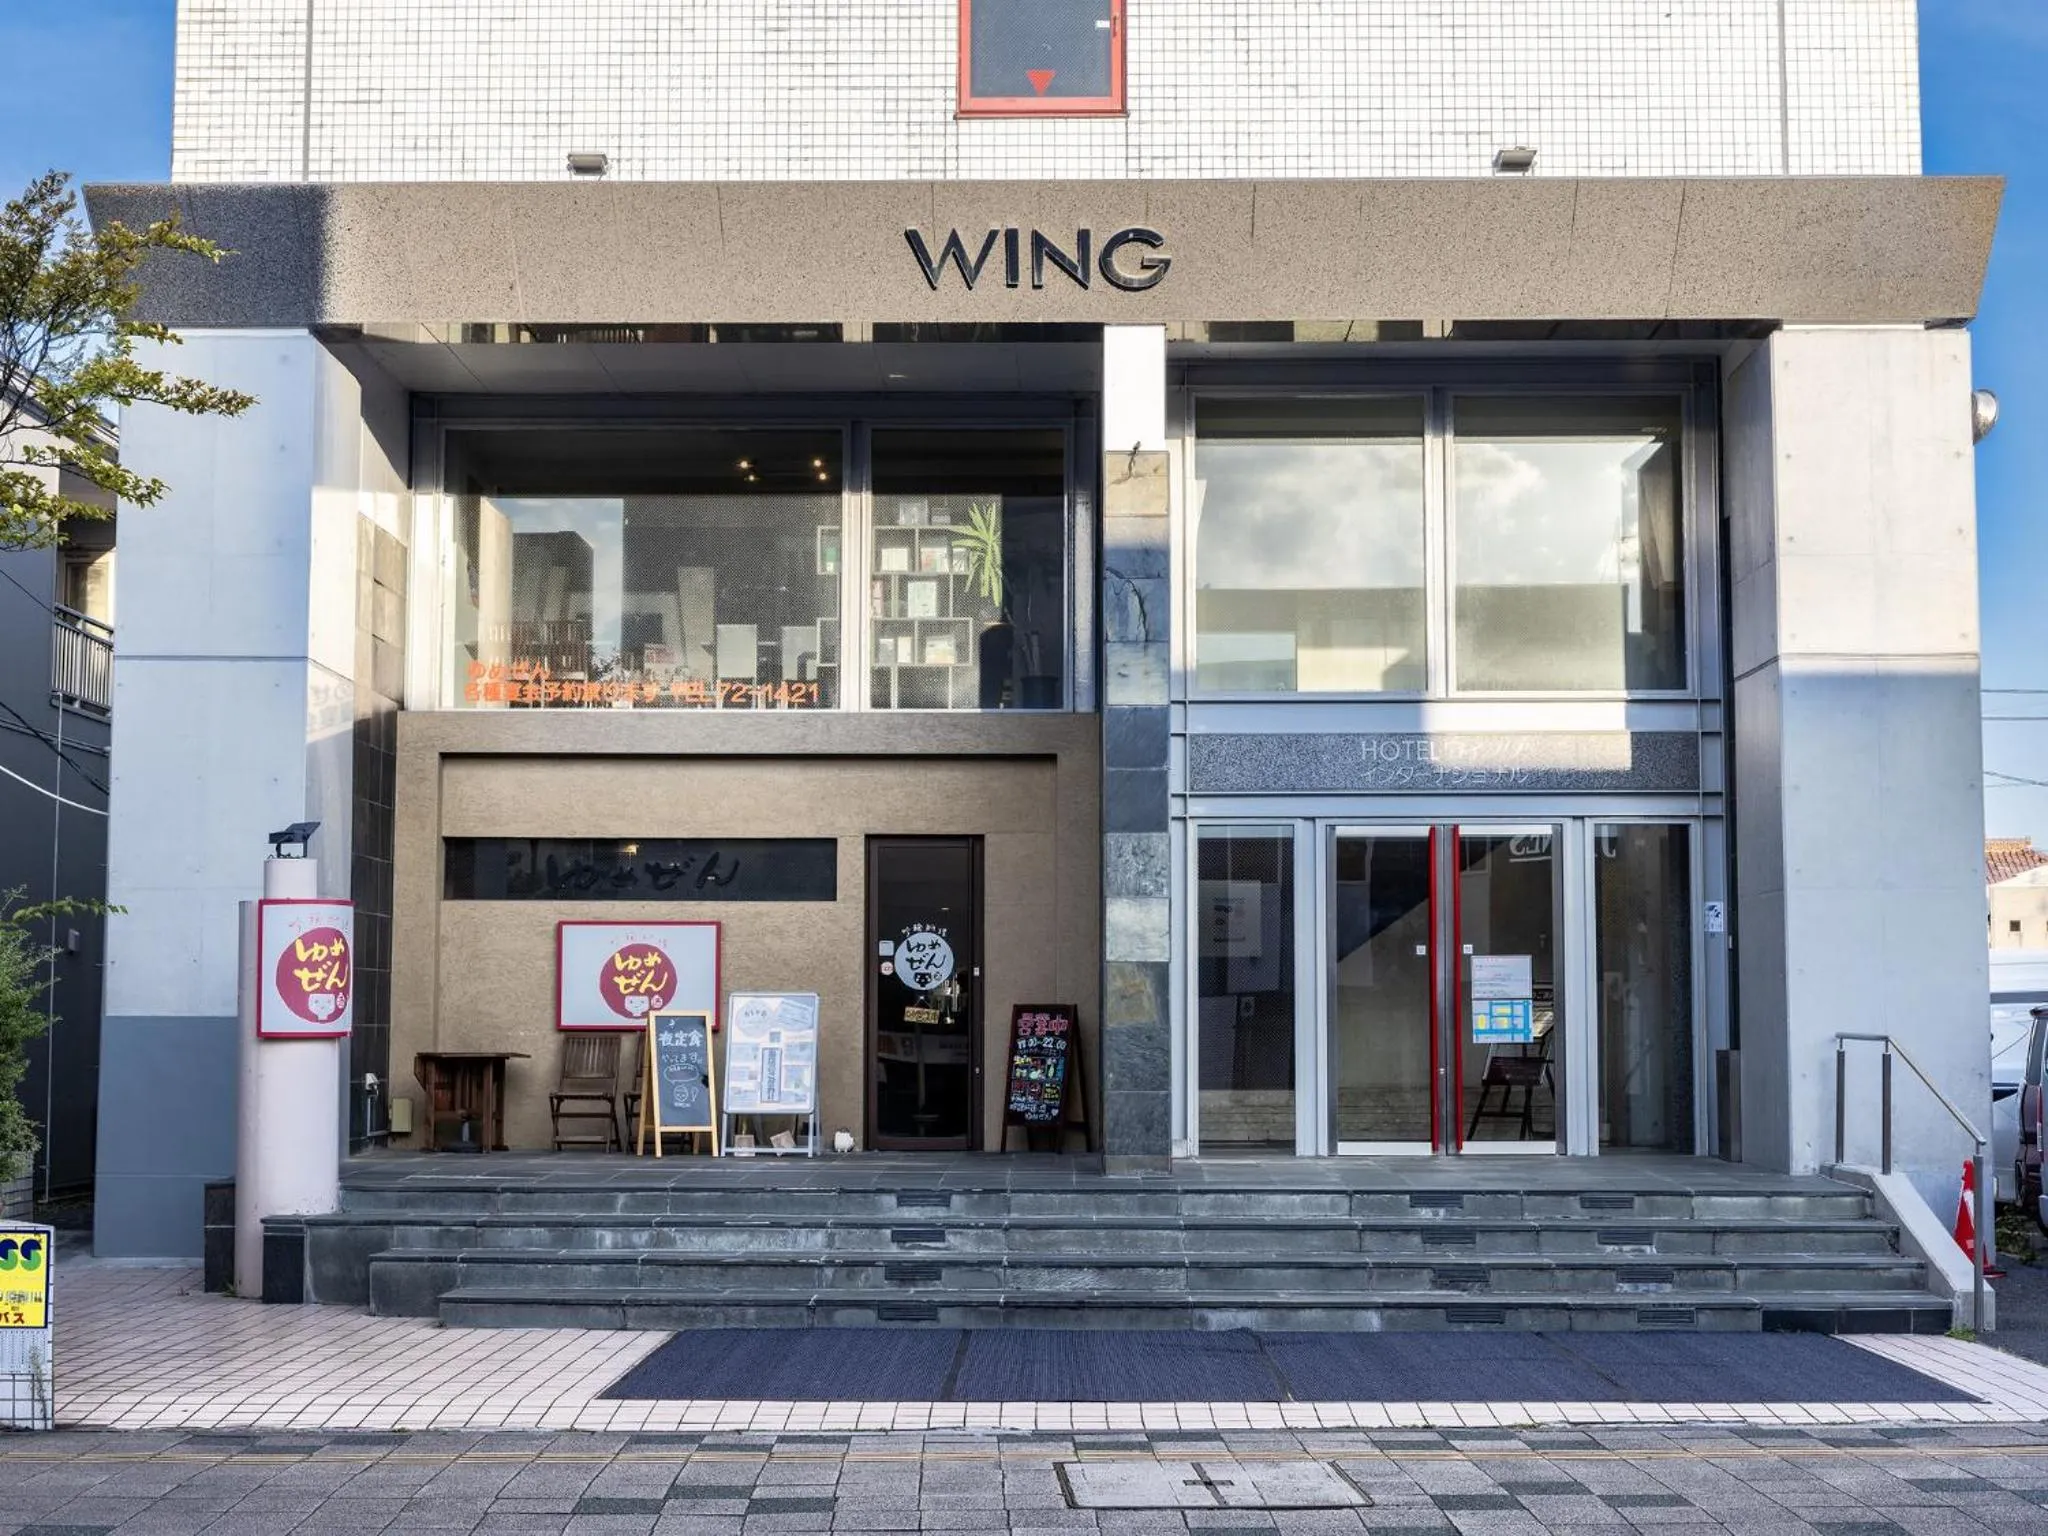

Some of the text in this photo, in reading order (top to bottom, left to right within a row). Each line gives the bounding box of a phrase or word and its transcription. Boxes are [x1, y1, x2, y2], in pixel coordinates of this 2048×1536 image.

[904, 227, 1172, 291] WING
[716, 680, 819, 703] 72-1421
[1361, 740, 1439, 761] HOTEL
[1360, 765, 1530, 784] インターナショナル
[546, 851, 740, 891] ゆめぜん
